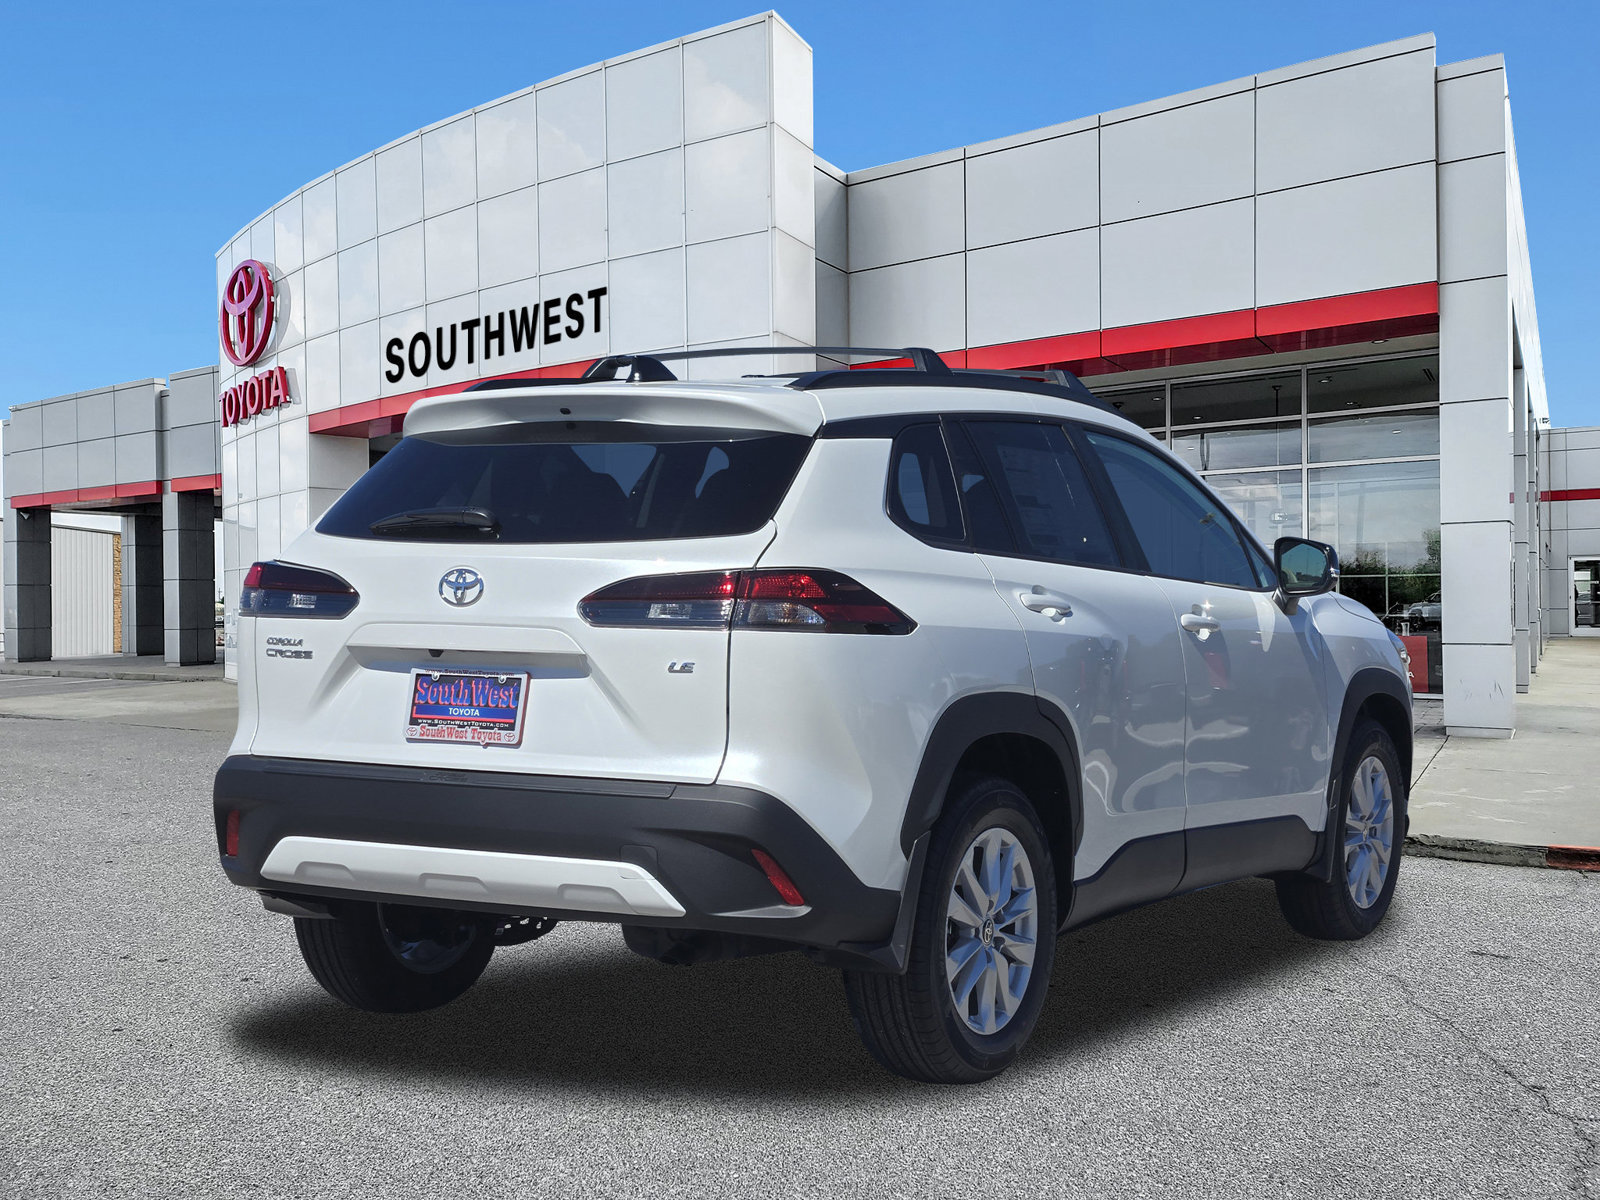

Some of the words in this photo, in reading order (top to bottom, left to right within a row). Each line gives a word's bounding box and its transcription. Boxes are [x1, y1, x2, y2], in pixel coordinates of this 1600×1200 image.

[385, 286, 608, 384] SOUTHWEST
[218, 365, 292, 428] TOYOTA
[266, 636, 304, 647] COROLLA
[266, 648, 313, 660] CROSS
[668, 662, 696, 673] LE
[448, 707, 480, 716] TOYOTA
[471, 728, 502, 743] Toyota
